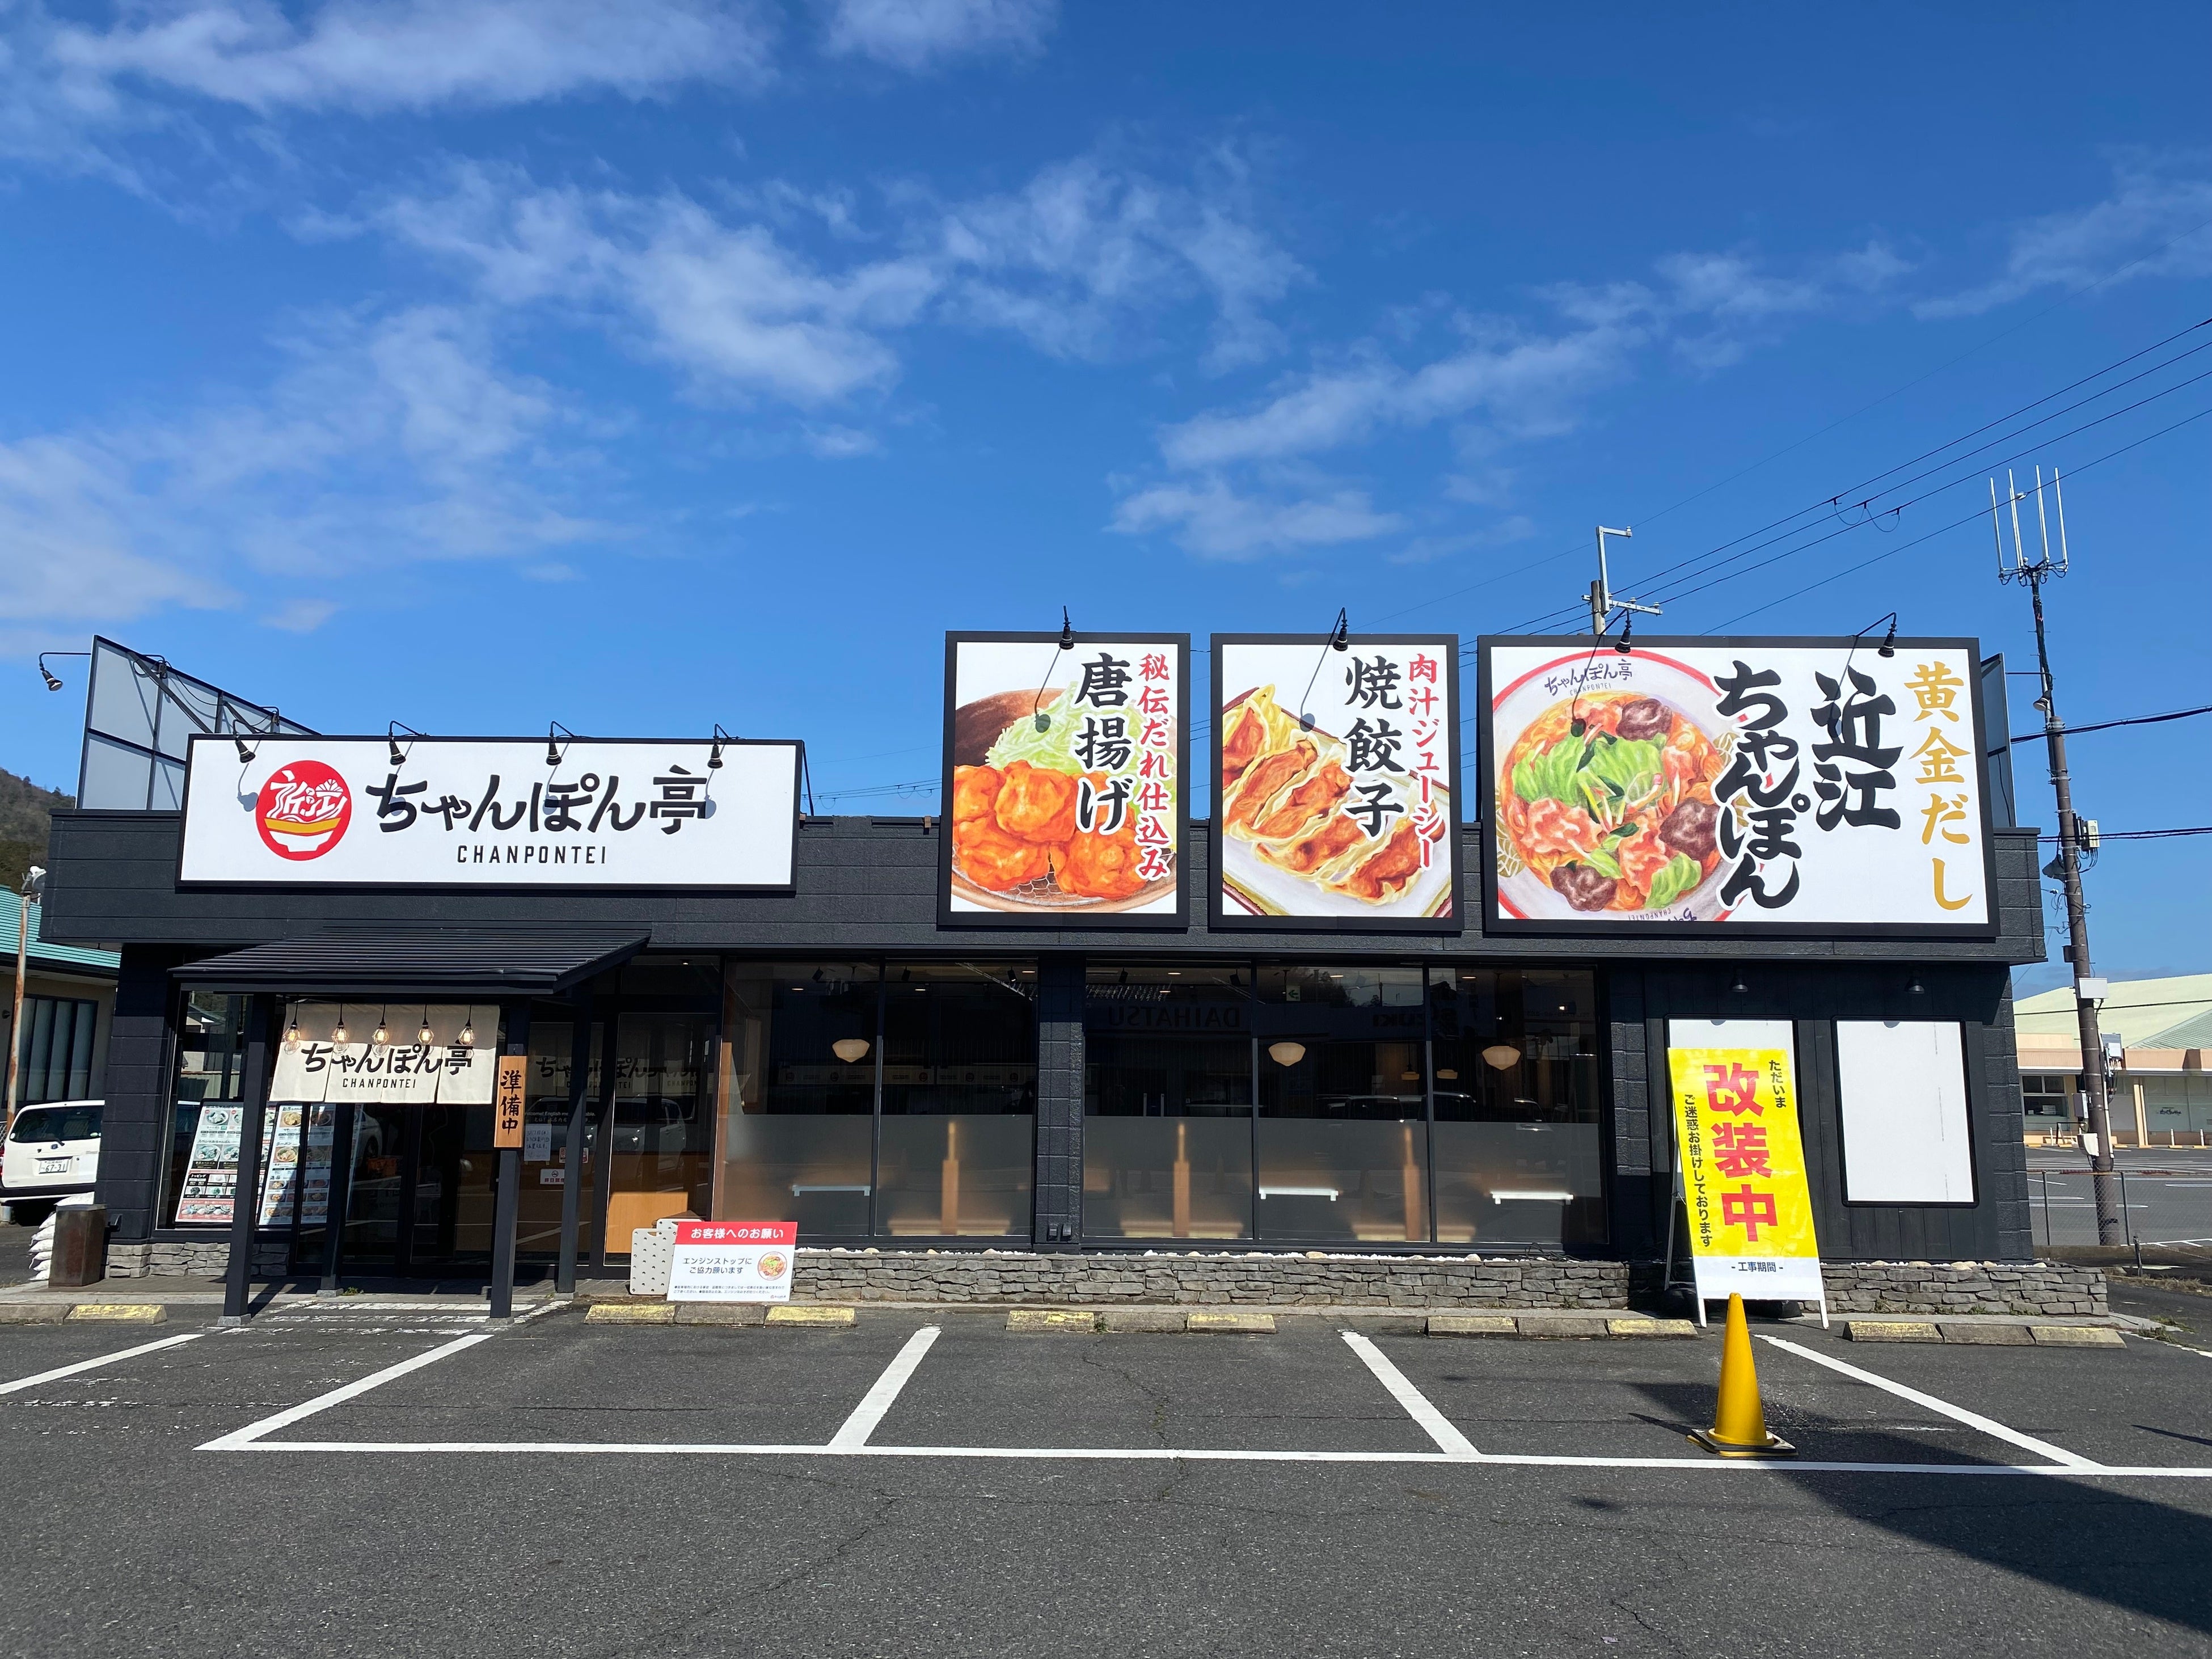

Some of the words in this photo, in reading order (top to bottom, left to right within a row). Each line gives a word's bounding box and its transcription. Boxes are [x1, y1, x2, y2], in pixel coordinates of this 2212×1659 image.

[1075, 652, 1133, 831] 唐揚げ
[1344, 655, 1406, 837] 焼餃子
[1544, 658, 1632, 696] ちゃんぽん亭
[1811, 665, 1903, 831] 近江
[366, 764, 707, 835] ちゃんぽん亭
[1137, 653, 1170, 877] 秘伝だれ仕込み
[1408, 653, 1440, 868] 肉汁ジューシー
[1714, 660, 1811, 909] ちゃんぽん
[1904, 661, 1973, 910] 黄金だし
[458, 846, 607, 864] CHANPONTEI
[301, 1039, 473, 1076] ちゃんぽん亭
[343, 1078, 416, 1088] CHANPONTEI
[500, 1070, 522, 1135] 準備中
[1768, 1059, 1787, 1108] ただいま
[1684, 1094, 1713, 1247] ご迷惑お掛けしております
[1703, 1063, 1777, 1242] 改装中
[691, 1228, 784, 1239] お客様へのお願い
